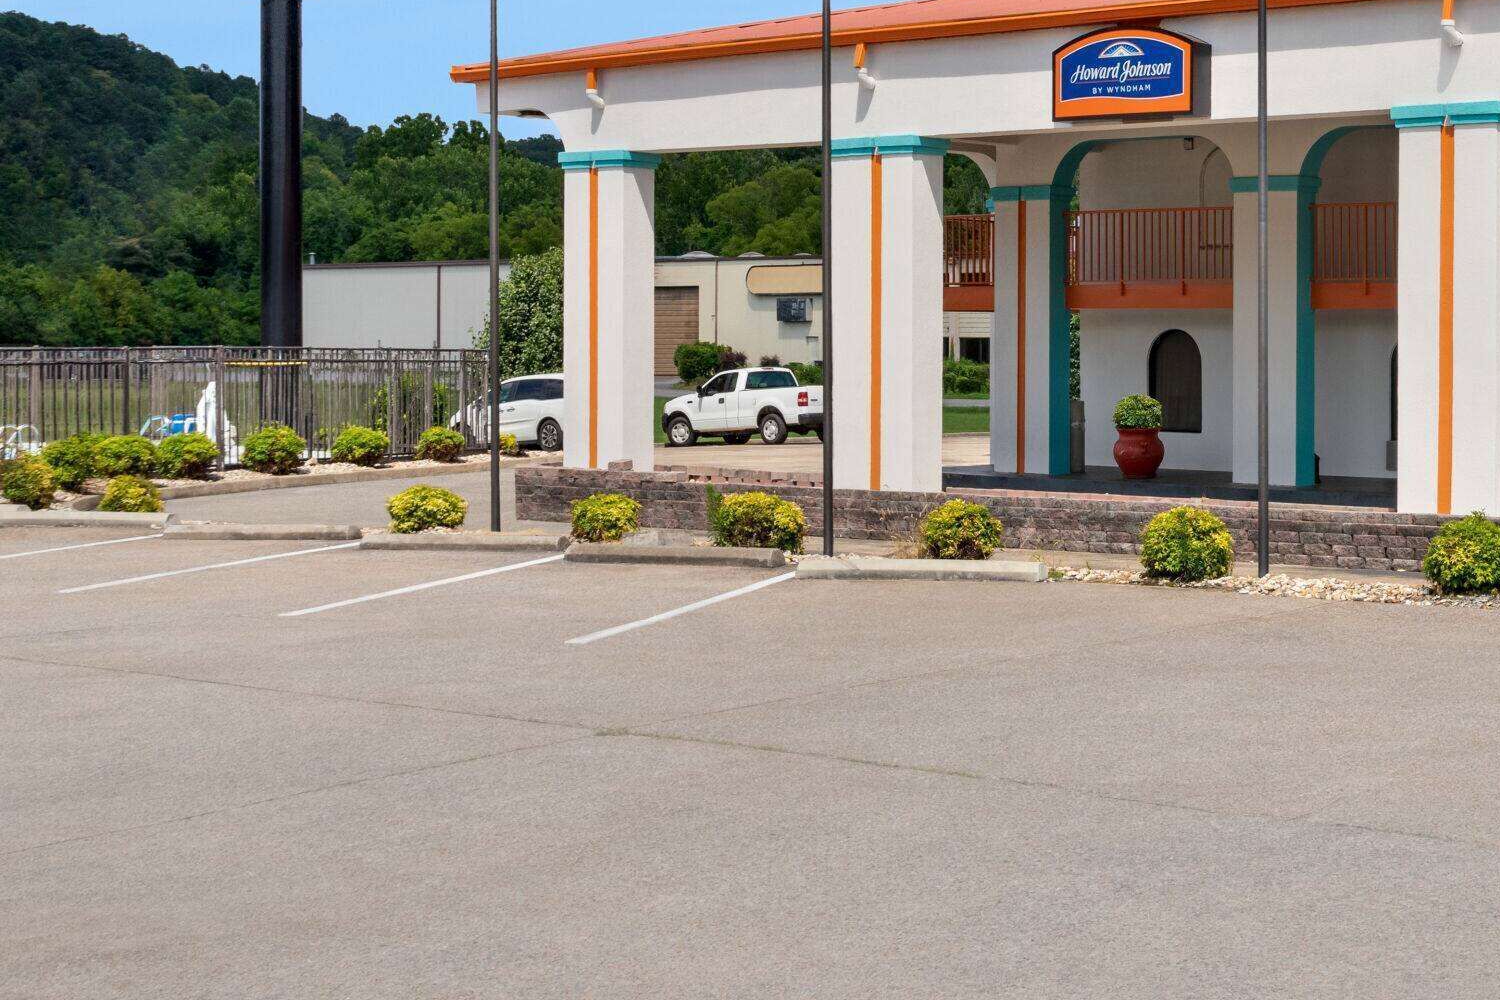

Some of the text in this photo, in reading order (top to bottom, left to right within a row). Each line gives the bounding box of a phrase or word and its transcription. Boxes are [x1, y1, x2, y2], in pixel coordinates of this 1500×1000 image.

[1070, 60, 1172, 84] Howard Johnson
[1092, 84, 1151, 95] BY WYNDHAM
